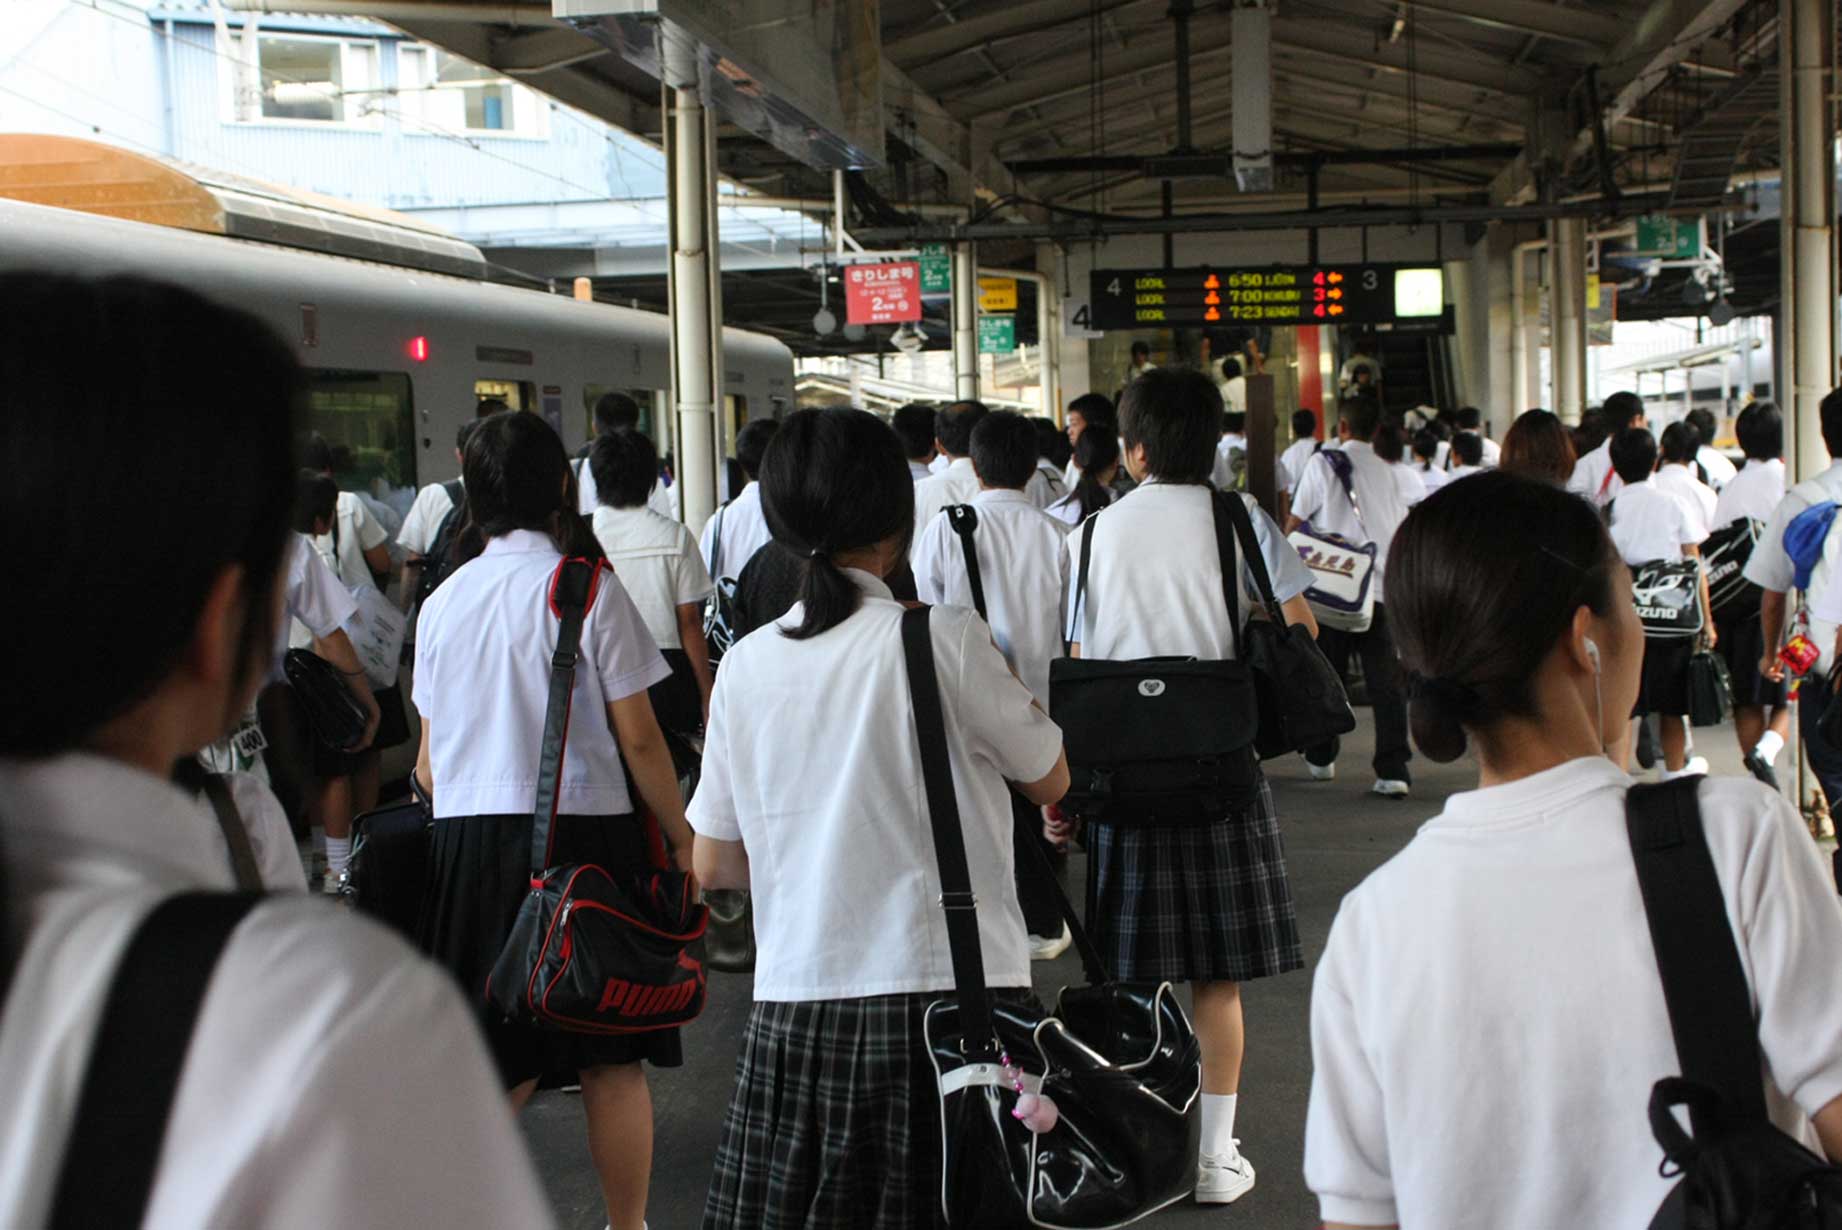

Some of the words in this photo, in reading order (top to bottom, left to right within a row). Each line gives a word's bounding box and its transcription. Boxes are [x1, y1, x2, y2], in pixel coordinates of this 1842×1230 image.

[1106, 277, 1122, 296] 4
[1229, 273, 1262, 287] 6:50
[1362, 269, 1378, 291] 3
[1229, 289, 1262, 303] 7:00
[1313, 287, 1326, 302] 3
[1072, 304, 1090, 330] 4
[1229, 305, 1262, 319] 7:23
[596, 978, 697, 1016] PUMA
